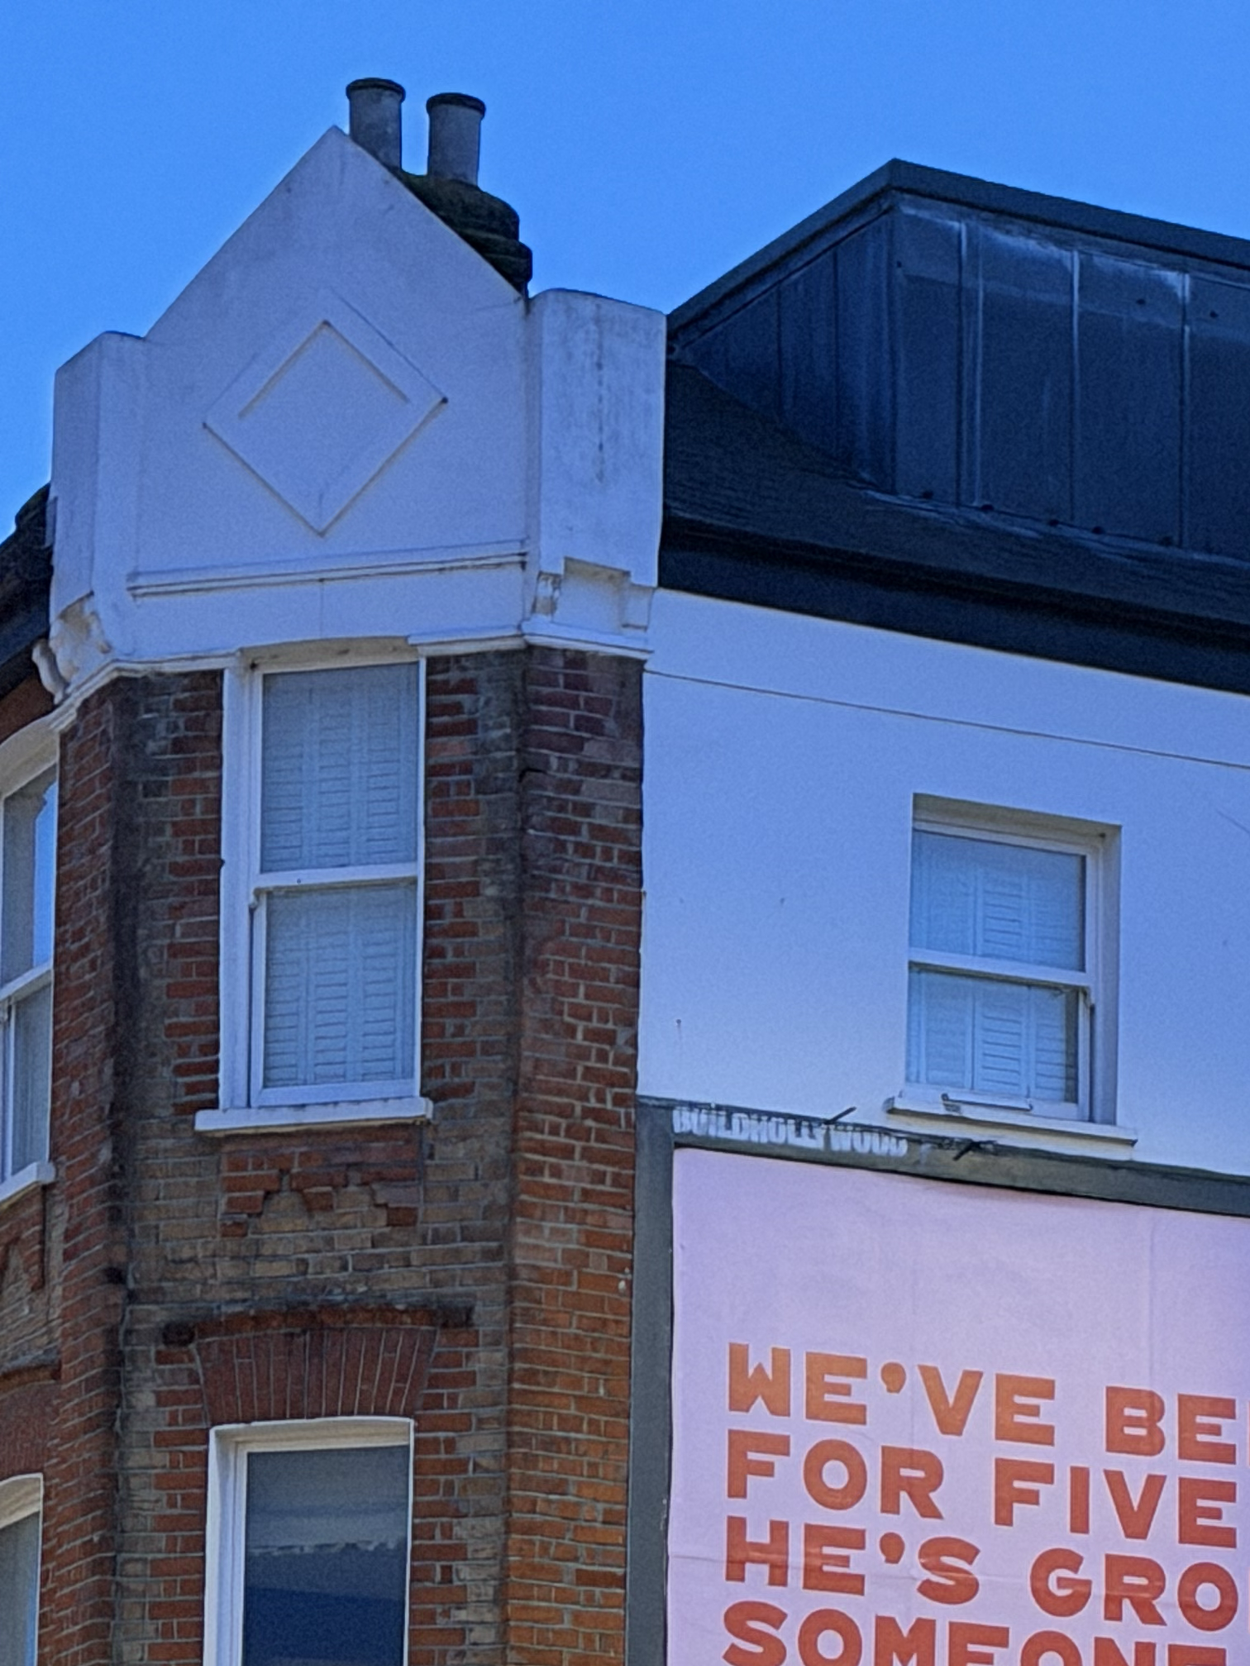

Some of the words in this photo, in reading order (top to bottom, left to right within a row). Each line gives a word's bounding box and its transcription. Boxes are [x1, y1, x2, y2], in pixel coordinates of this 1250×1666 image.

[728, 1342, 1055, 1446] WE'VE
[727, 1429, 945, 1520] FOR
[994, 1457, 1237, 1549] FIVE
[725, 1515, 981, 1605] HE'S
